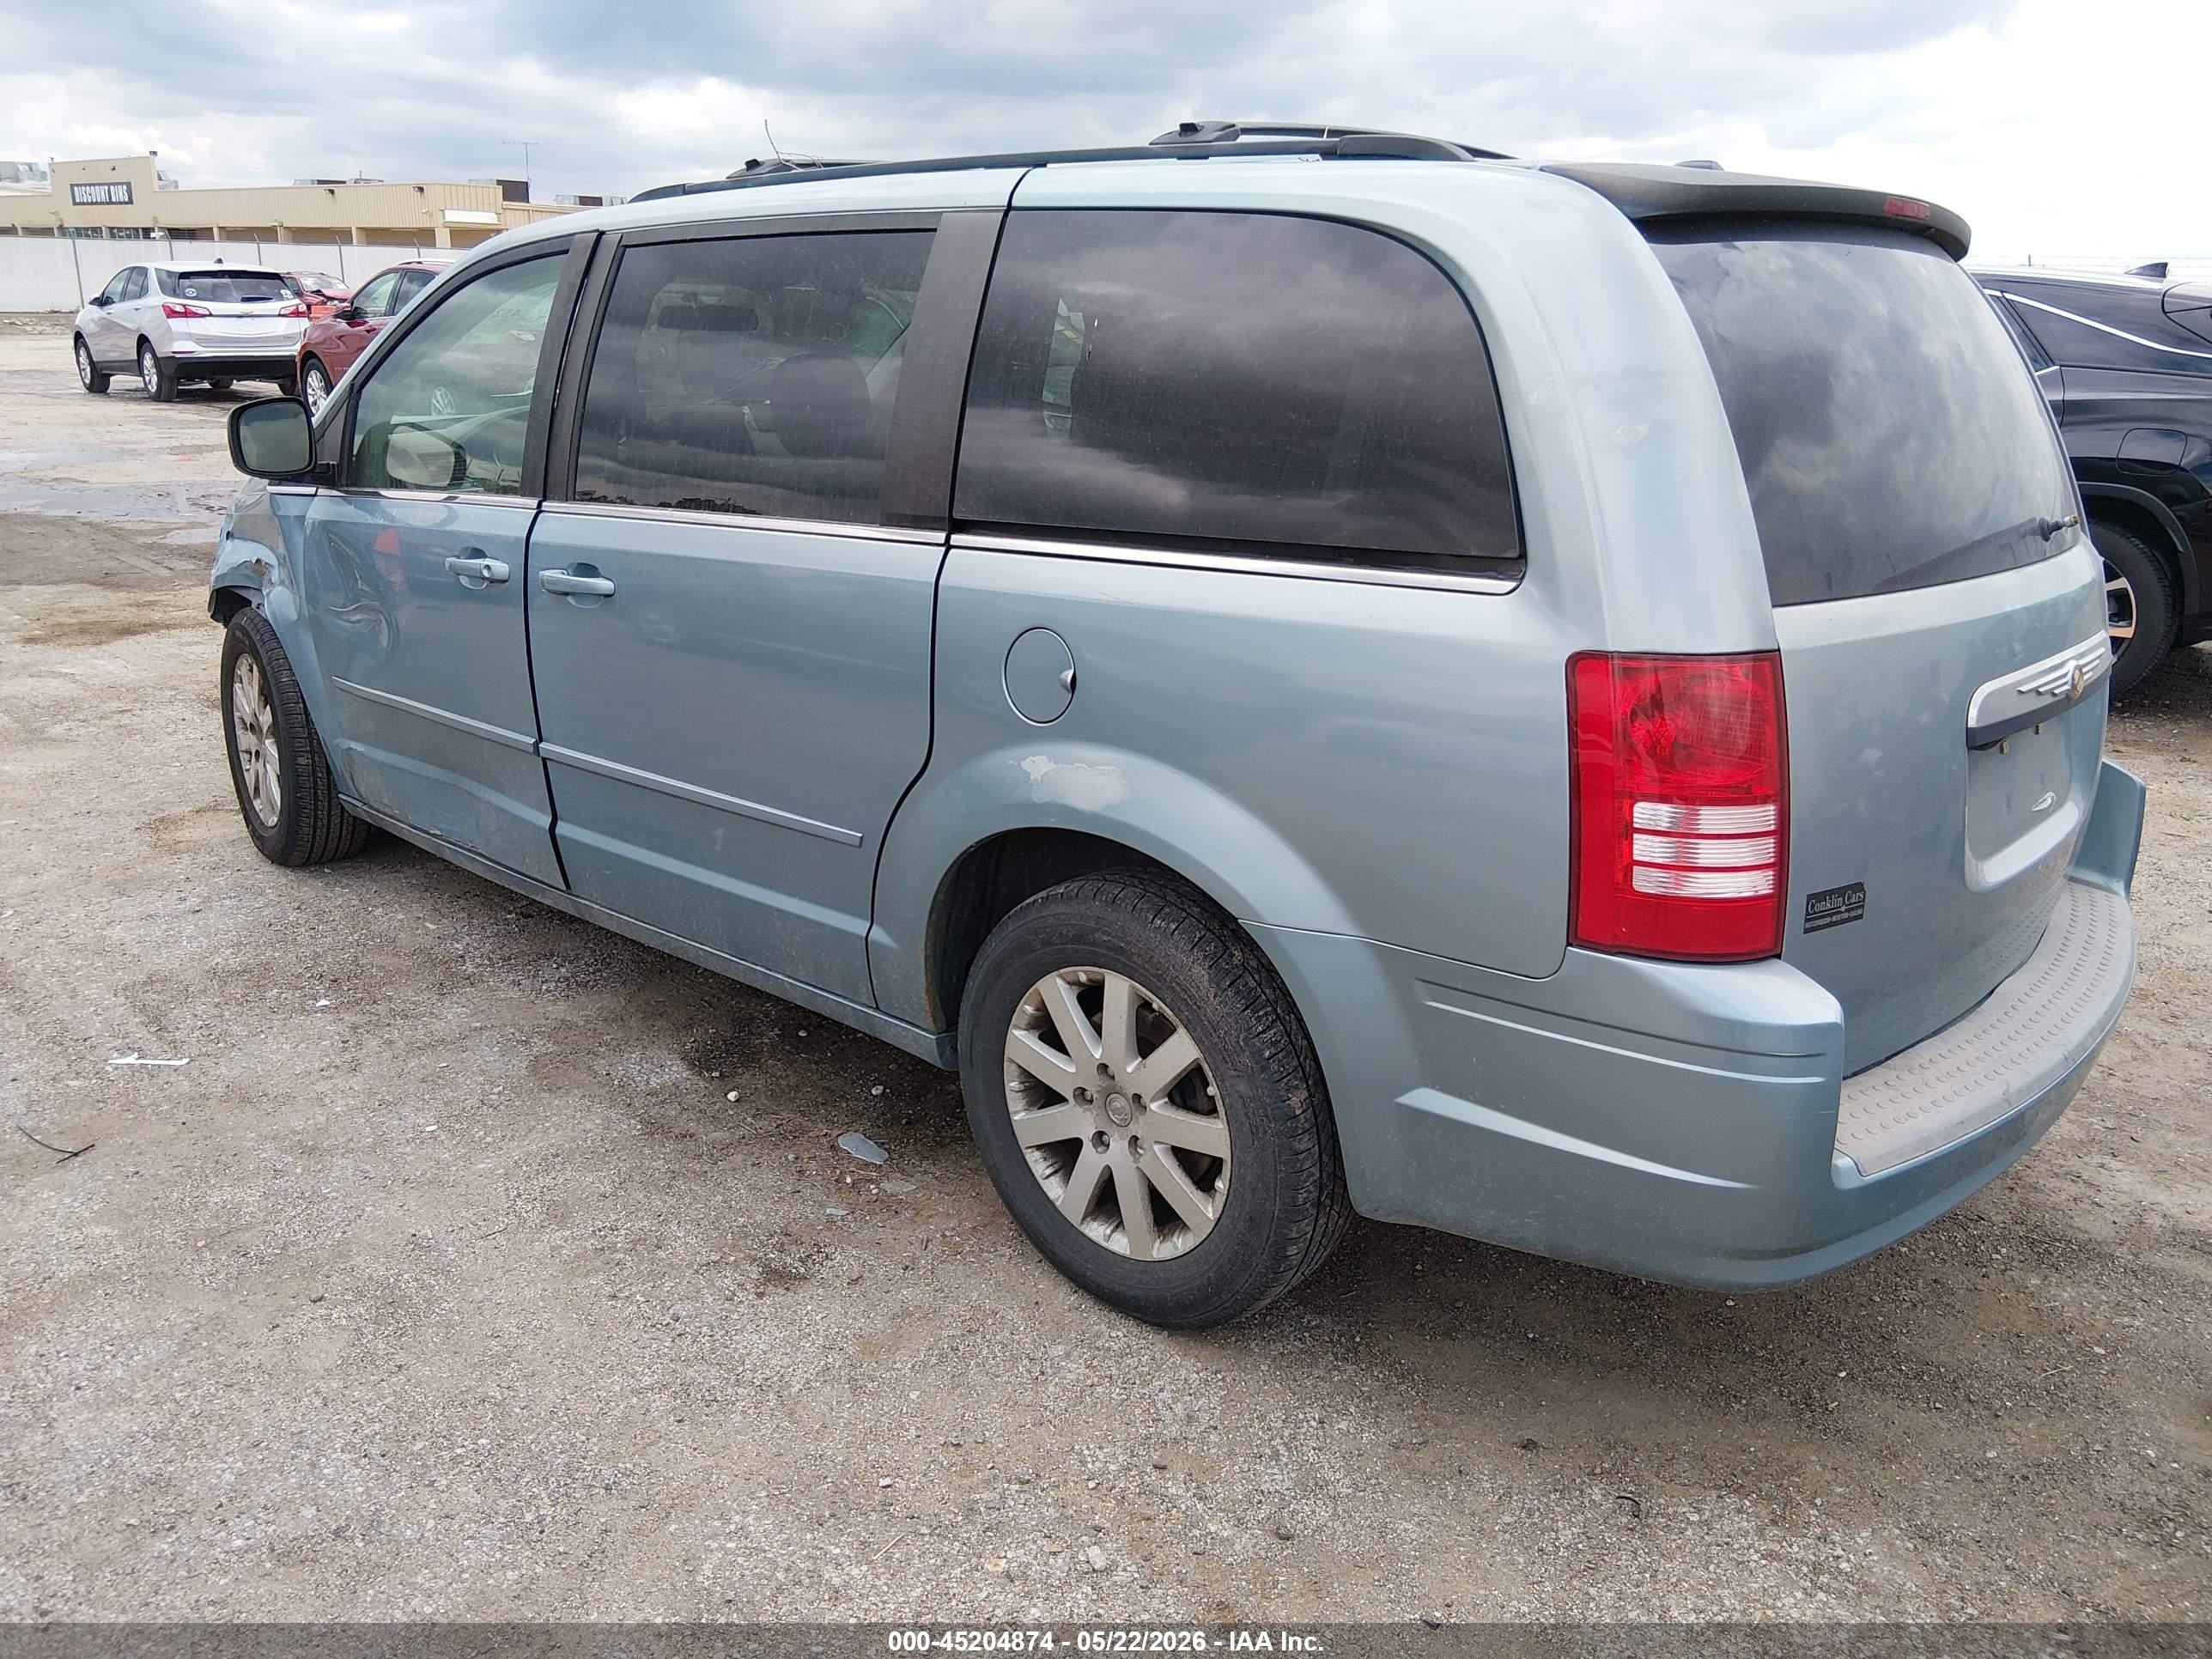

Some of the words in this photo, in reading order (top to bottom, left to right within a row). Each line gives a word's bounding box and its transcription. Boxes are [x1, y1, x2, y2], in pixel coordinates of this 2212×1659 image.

[74, 185, 109, 203] DISCOUNT
[110, 185, 129, 203] BINS
[1808, 894, 1843, 914] Conklin
[1844, 890, 1864, 904] Cars
